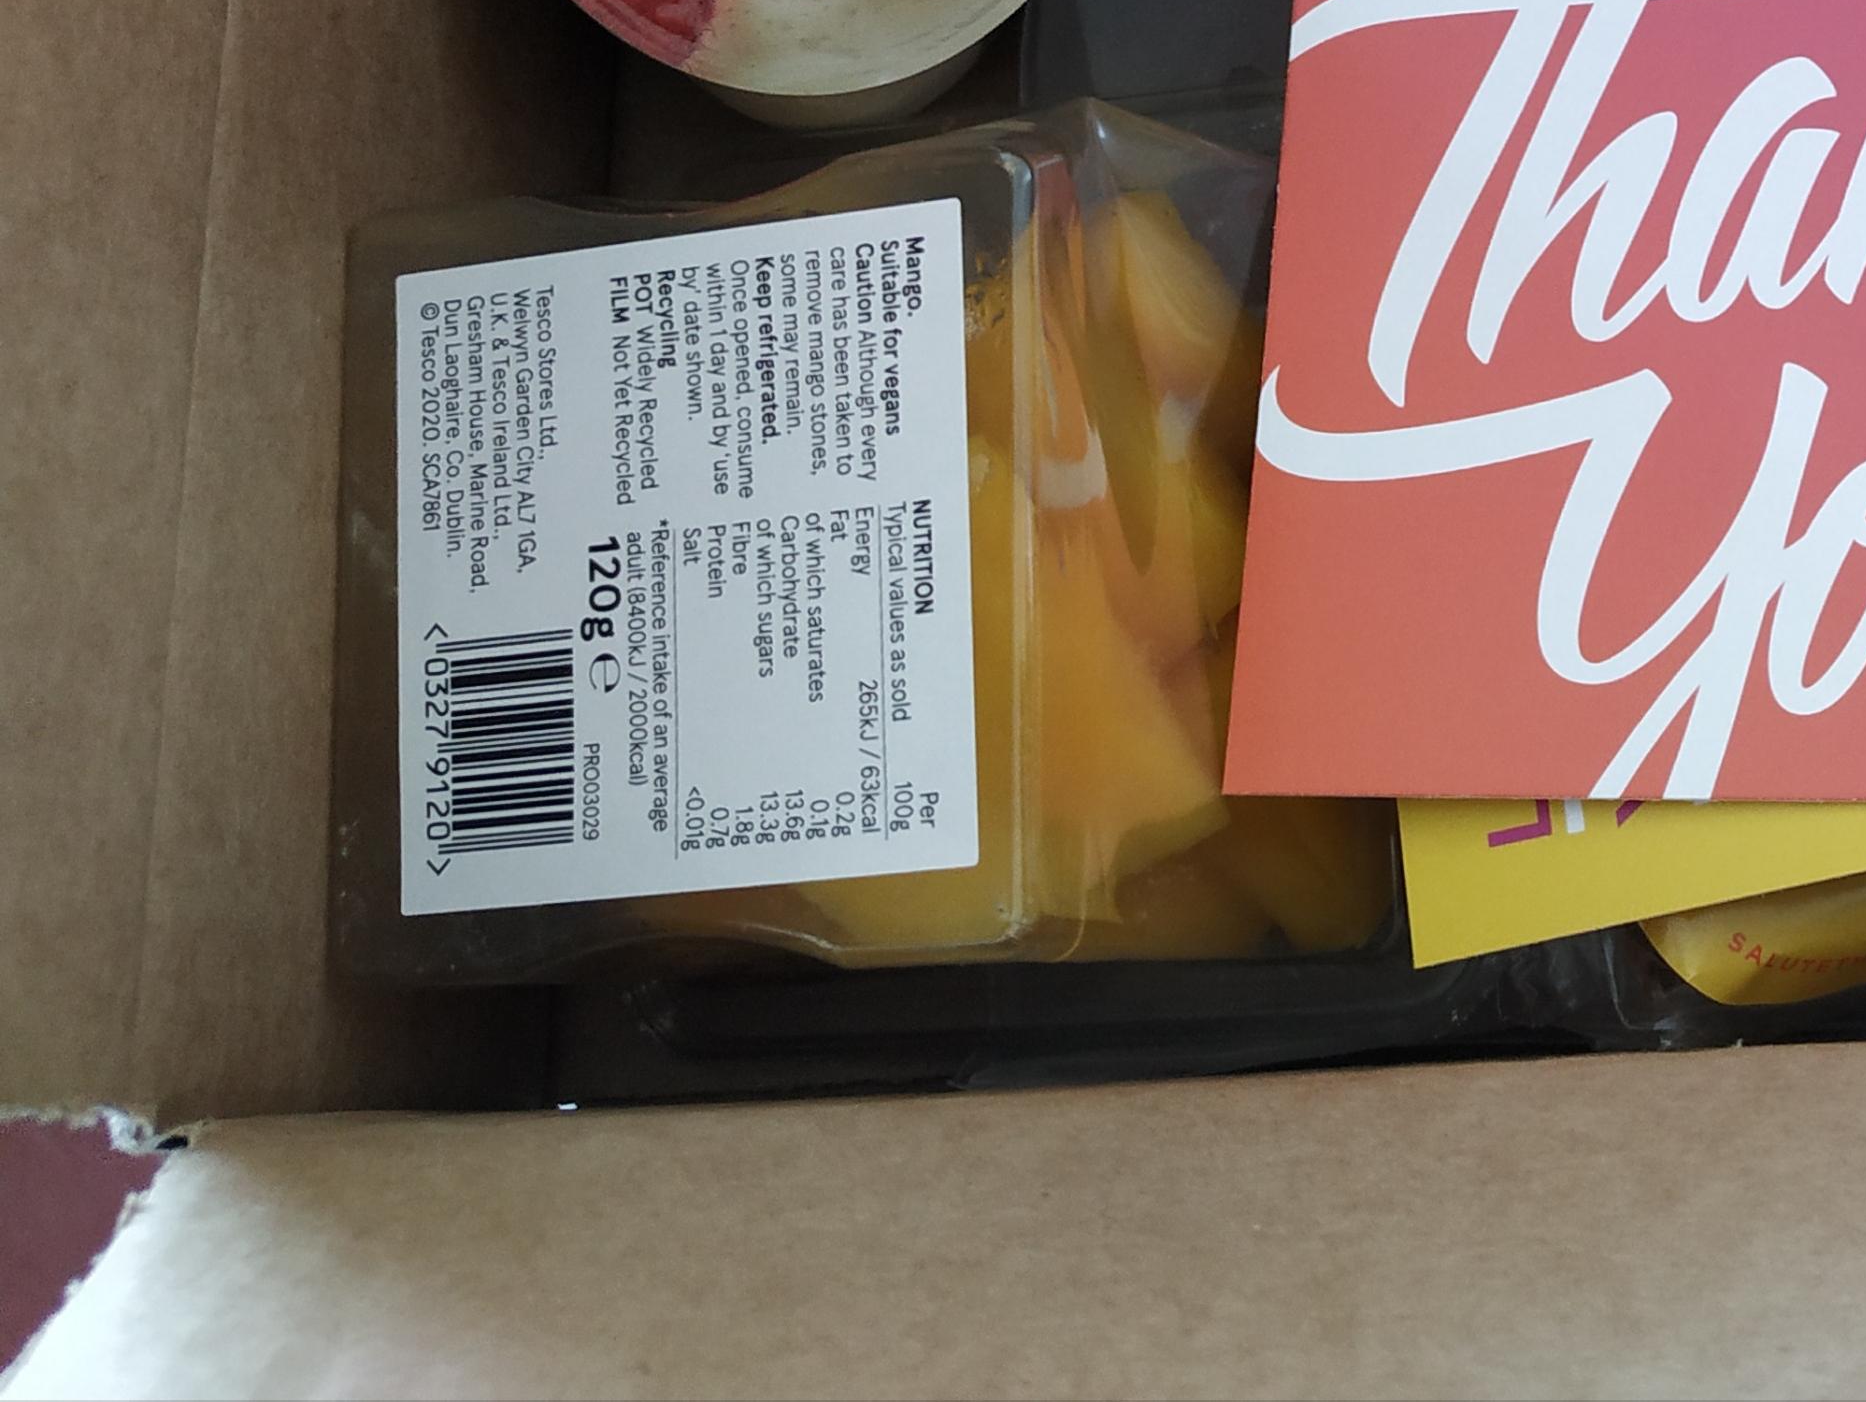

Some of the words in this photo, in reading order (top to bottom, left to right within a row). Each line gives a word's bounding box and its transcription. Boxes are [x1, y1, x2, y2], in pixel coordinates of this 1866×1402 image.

[608, 274, 631, 324] FILM
[633, 271, 655, 315] POT
[728, 258, 752, 314] Once
[750, 255, 776, 313] Keep
[779, 252, 797, 310] some
[803, 248, 823, 326] remove
[853, 241, 877, 325] Caution
[878, 239, 903, 324] Suitable
[901, 235, 926, 318] Mango.
[441, 297, 463, 338] Dun
[463, 294, 488, 385] Gresham
[510, 287, 533, 364] Welwyn
[533, 283, 555, 343] Tesco
[654, 268, 681, 369] Recycling
[776, 311, 800, 354] may
[880, 326, 903, 359] for
[535, 346, 557, 411] Stores
[610, 333, 632, 373] Not
[633, 323, 657, 393] Widely
[727, 317, 756, 401] opened,
[753, 312, 782, 445] refrigerated.
[803, 329, 825, 398] mango
[853, 328, 880, 419] Although
[438, 340, 466, 445] Laoghaire,
[464, 388, 488, 458] House,
[508, 366, 535, 444] Garden
[613, 374, 633, 410] Yet
[783, 357, 805, 435] remain.
[878, 362, 900, 436] vegans
[443, 448, 465, 488] Co.
[510, 444, 535, 487] City
[535, 414, 559, 460] Ltd.,
[610, 411, 637, 506] Recycled
[632, 397, 659, 491] Recycled
[735, 404, 754, 499] consume
[808, 401, 829, 476] stones,
[855, 422, 877, 481] every
[444, 488, 467, 558] Dublin.
[464, 462, 492, 532] Marine
[514, 489, 536, 525] AL7
[828, 508, 851, 543] Fat
[468, 535, 490, 593] Road,
[515, 528, 537, 574] 1GA,
[681, 526, 703, 567] Salt
[705, 523, 727, 599] Protein
[730, 520, 752, 576] Fibre
[849, 505, 875, 576] Energy
[883, 499, 908, 573] Typical
[911, 498, 935, 615] NUTRITION
[578, 534, 622, 642] 120g
[775, 514, 804, 659] Carbohydrate
[887, 576, 909, 644] values
[889, 648, 906, 673] as
[889, 677, 912, 722] sold
[679, 785, 708, 852] <0.01g
[703, 806, 730, 850] 0.7g
[728, 805, 755, 848] 1.8g
[752, 790, 780, 845] 13.3g
[778, 788, 805, 843] 13.6g
[804, 798, 831, 841] 0.1g
[829, 790, 856, 838] 0.2g
[888, 780, 915, 833] 100g
[917, 790, 940, 829] Per
